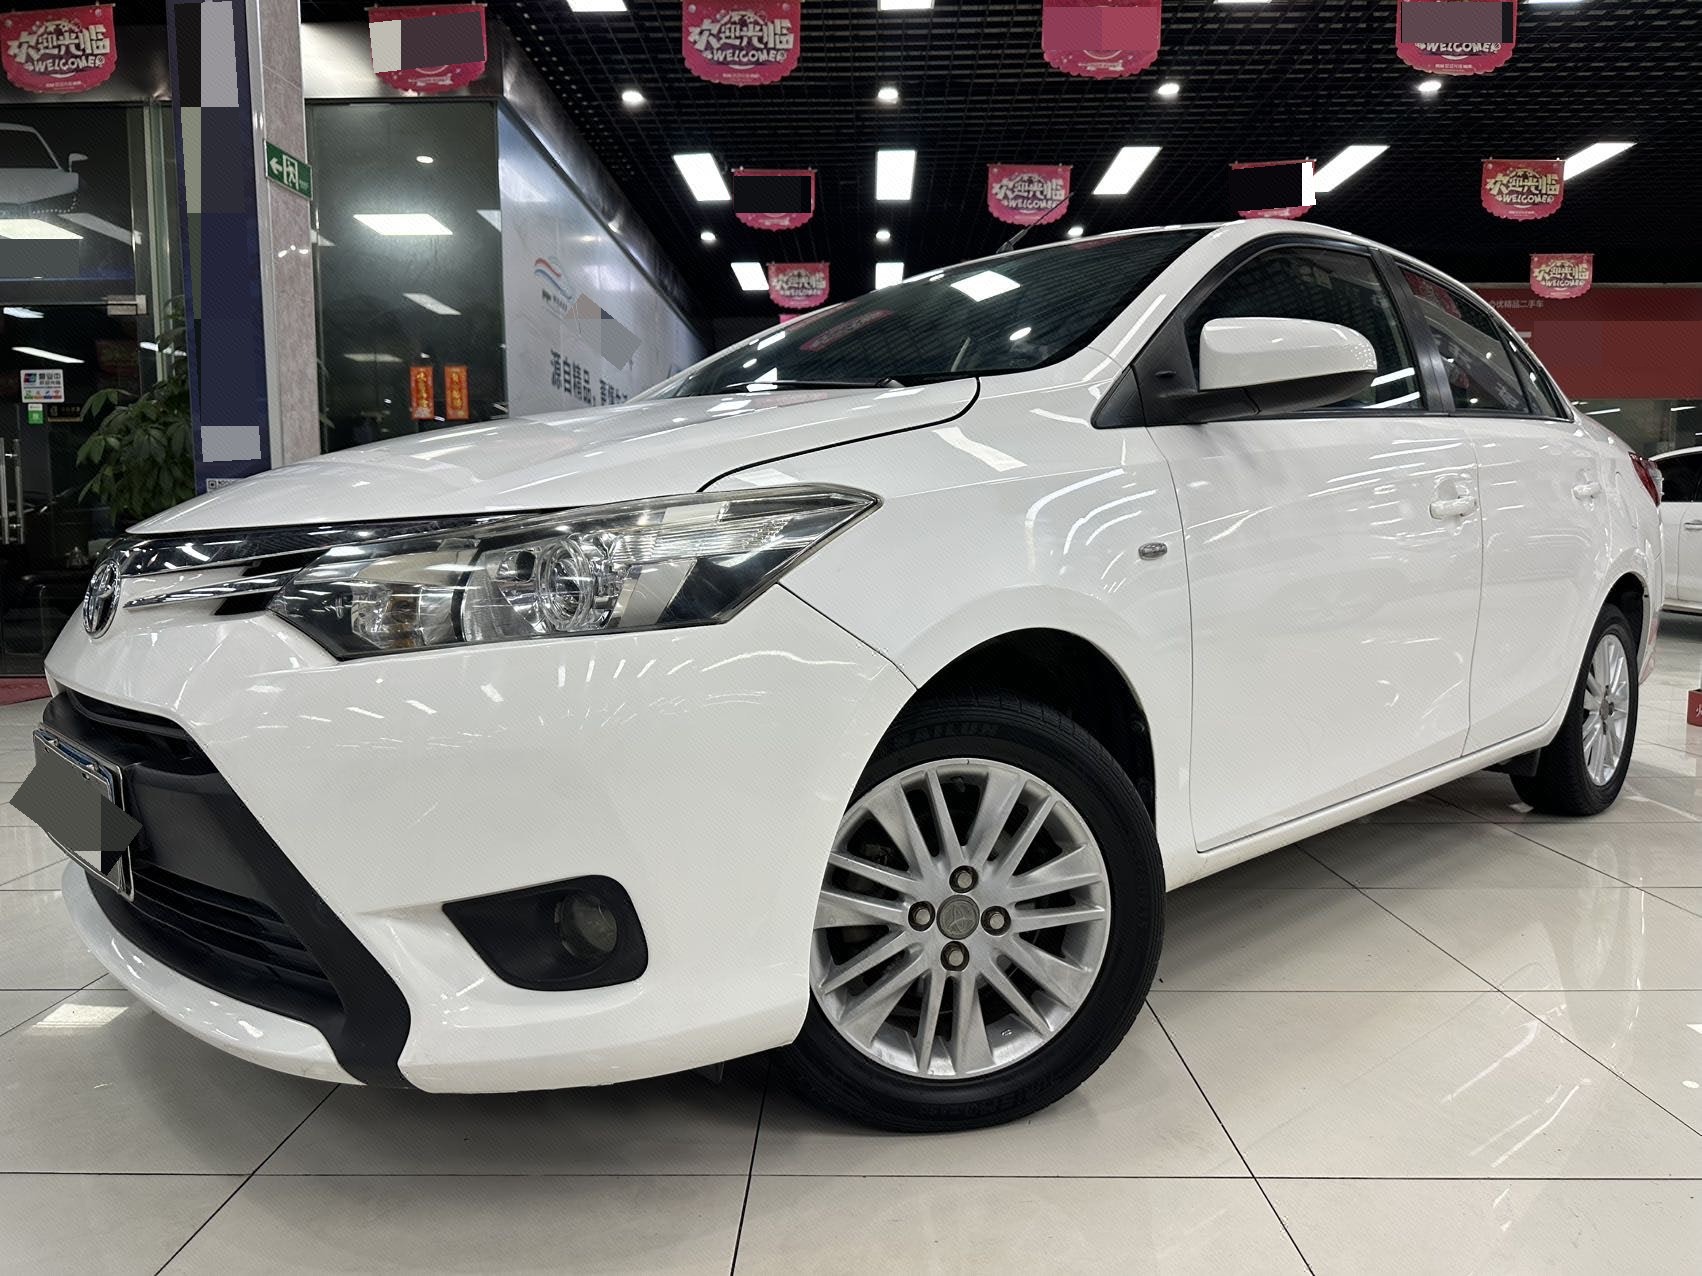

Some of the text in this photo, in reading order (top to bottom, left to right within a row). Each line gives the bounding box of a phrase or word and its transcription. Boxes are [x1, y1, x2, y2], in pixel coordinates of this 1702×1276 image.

[7, 24, 111, 63] 欢迎光临
[687, 18, 795, 51] 欢迎光临
[34, 55, 96, 72] WELCOME
[713, 49, 778, 62] WELCOME
[991, 178, 1066, 201] 欢迎光临
[1485, 173, 1560, 195] 欢迎光临
[1502, 194, 1548, 204] WELCOME
[1533, 263, 1589, 281] 欢迎光临
